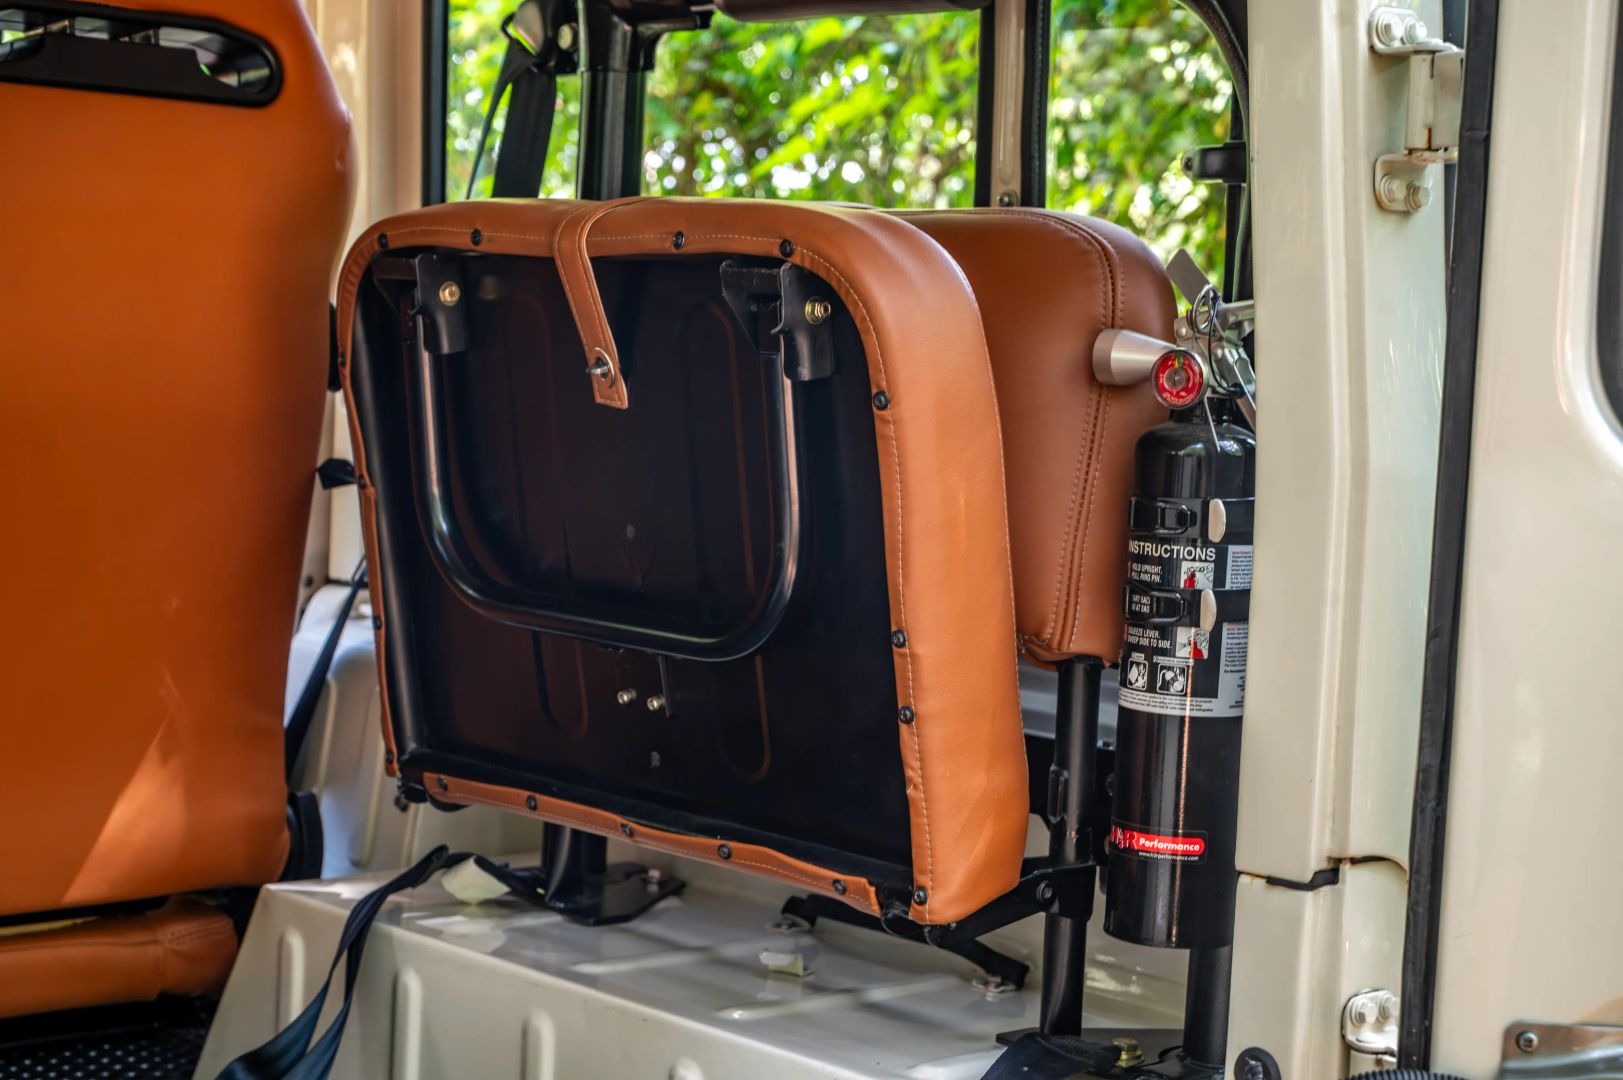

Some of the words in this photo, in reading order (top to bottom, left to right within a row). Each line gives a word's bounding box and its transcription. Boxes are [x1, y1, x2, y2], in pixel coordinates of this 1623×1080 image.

[1128, 540, 1216, 561] INSTRUCTIONS
[1139, 638, 1150, 646] SIDE
[1150, 639, 1158, 648] TO
[1139, 837, 1200, 851] Performance
